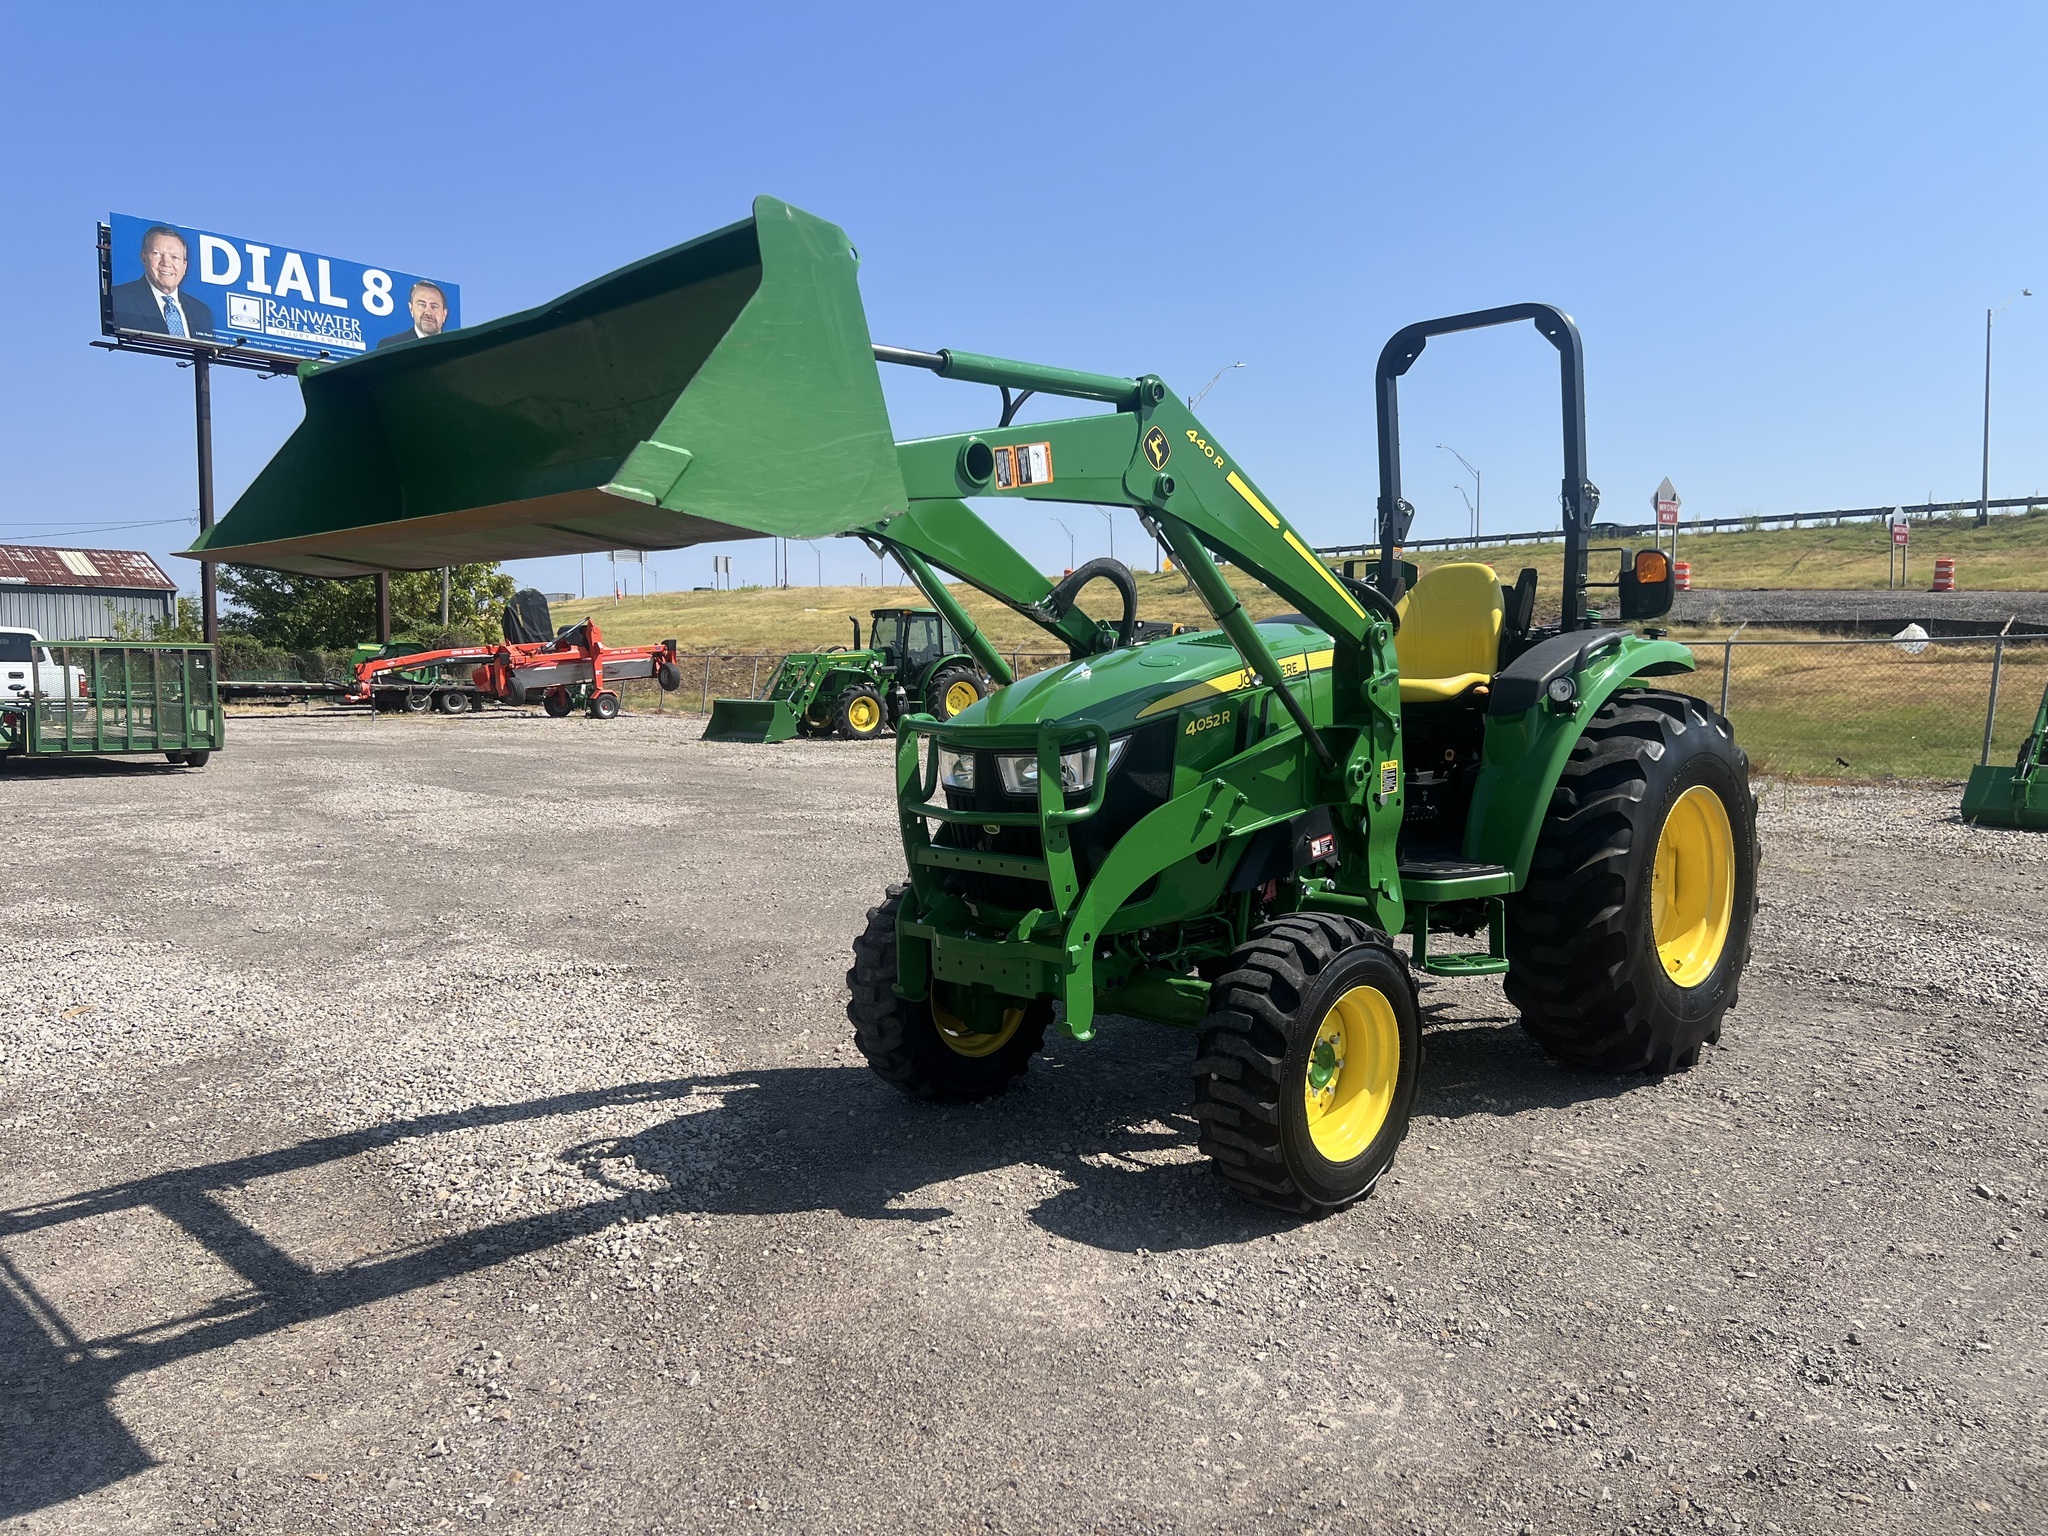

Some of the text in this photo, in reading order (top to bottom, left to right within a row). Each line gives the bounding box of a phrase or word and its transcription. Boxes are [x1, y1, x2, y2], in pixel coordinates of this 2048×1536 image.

[199, 234, 394, 316] DIAL 8
[265, 299, 362, 333] RAINWATER
[265, 316, 361, 342] HOLT & SEXTON
[276, 329, 309, 339] INJURY
[1662, 513, 1674, 521] WAY
